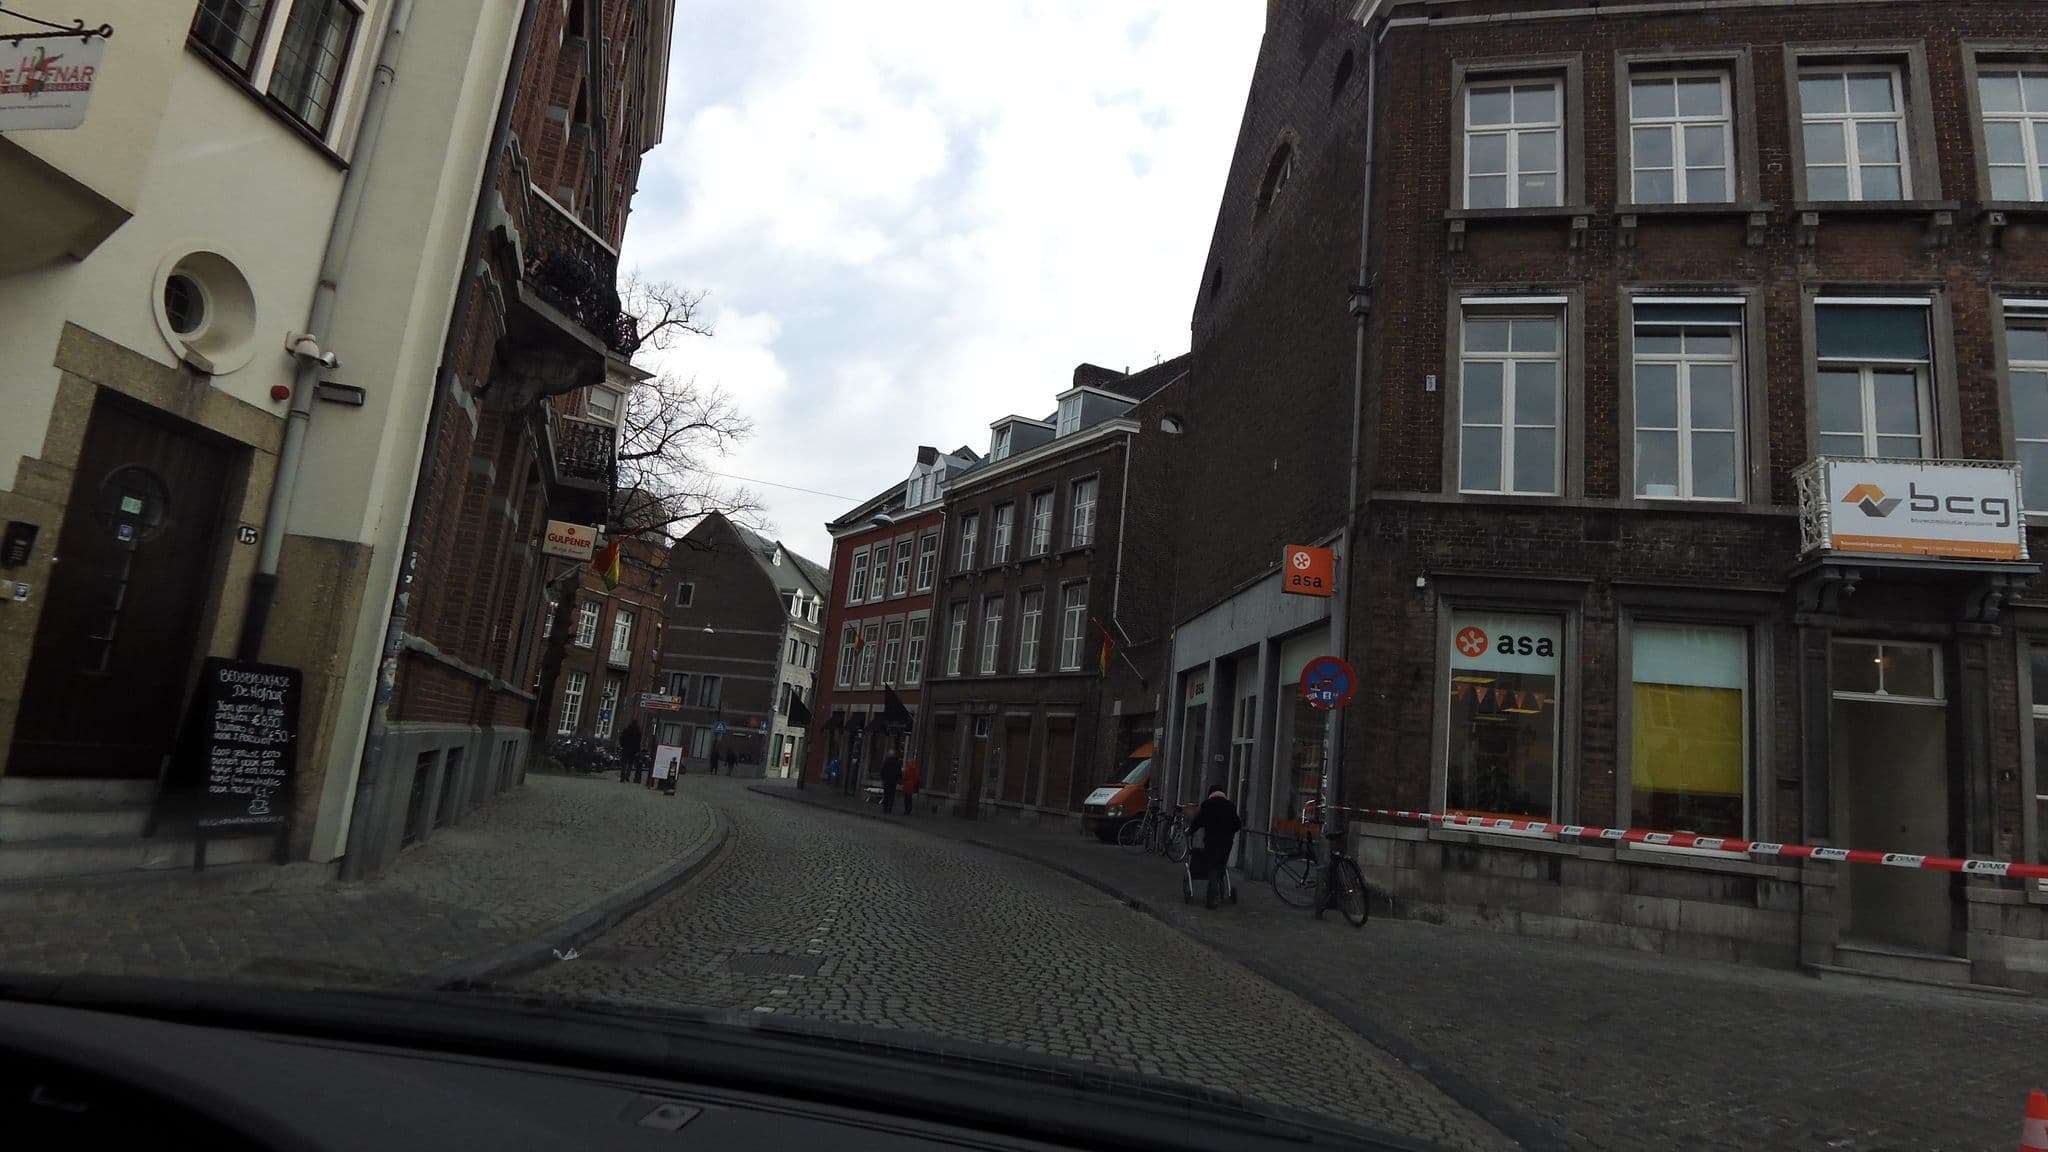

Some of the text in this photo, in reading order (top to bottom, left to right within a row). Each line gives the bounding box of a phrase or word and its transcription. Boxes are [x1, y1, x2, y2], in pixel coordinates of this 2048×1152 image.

[1909, 482, 2010, 527] bcg
[241, 528, 256, 544] 15
[547, 533, 591, 548] GULPENER
[1292, 574, 1322, 588] asa
[1497, 635, 1555, 657] asa
